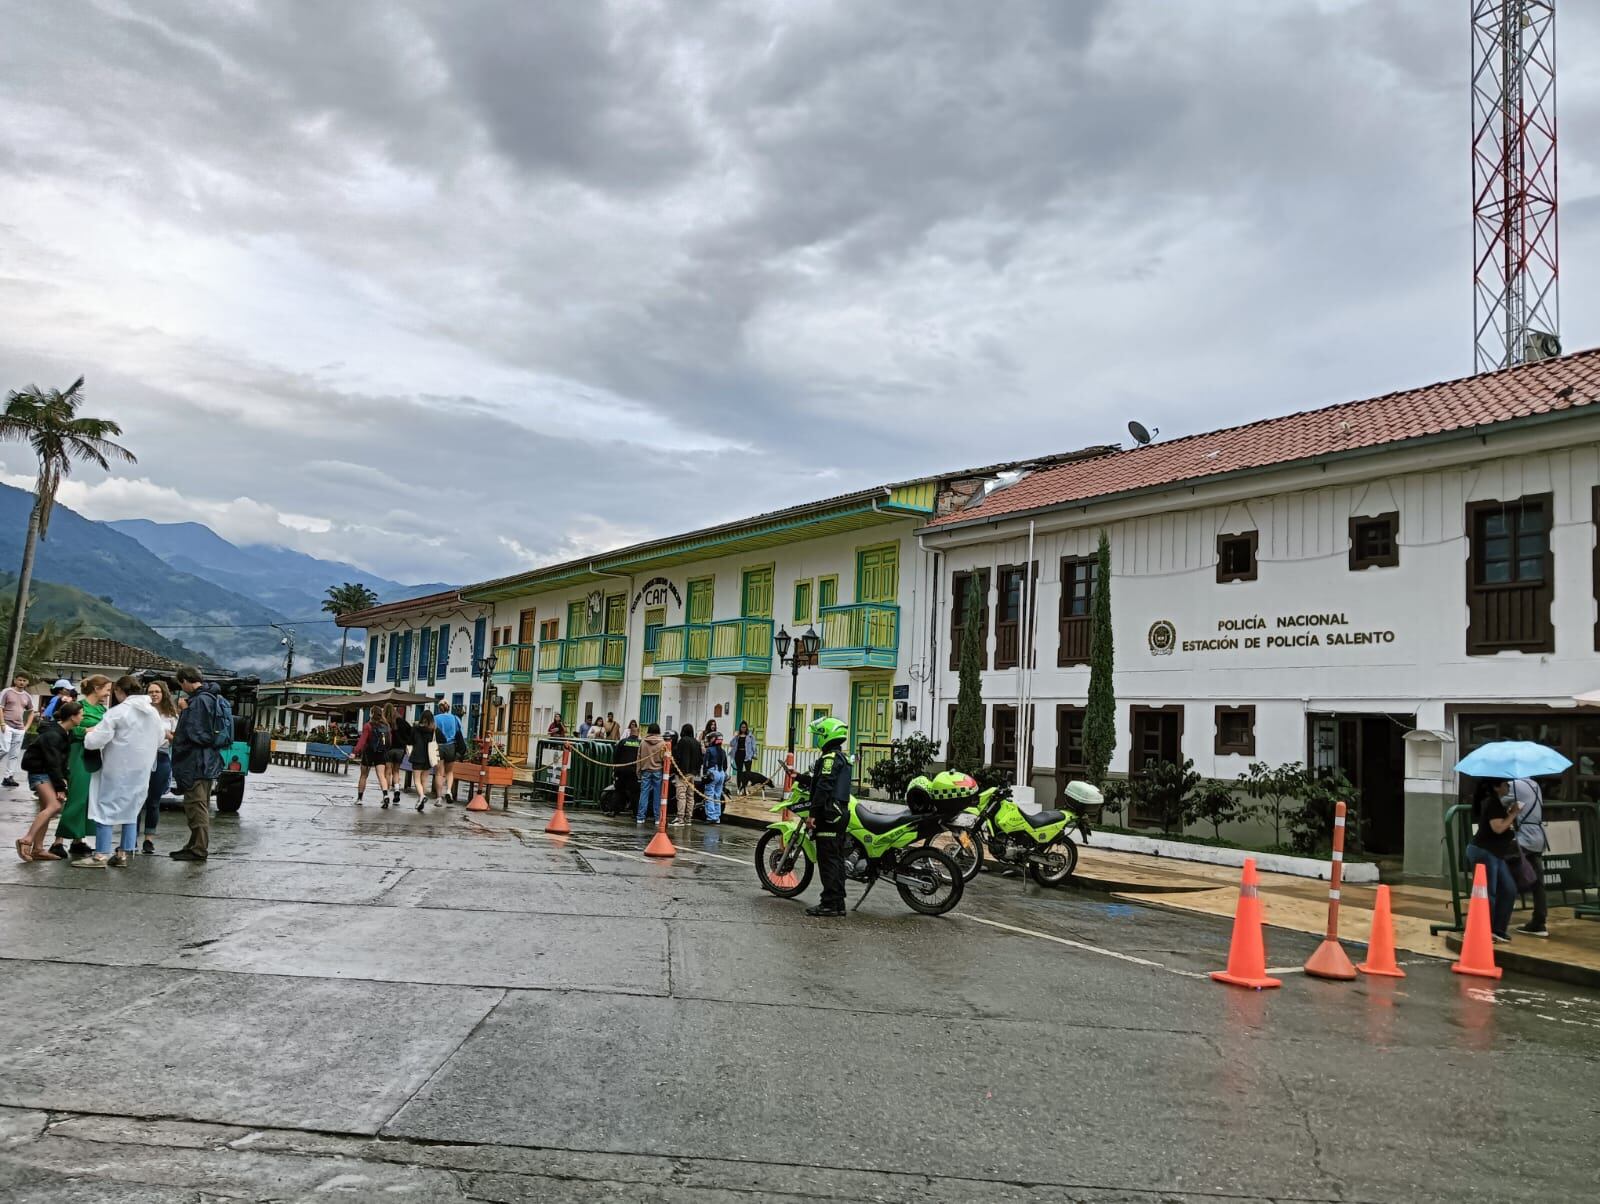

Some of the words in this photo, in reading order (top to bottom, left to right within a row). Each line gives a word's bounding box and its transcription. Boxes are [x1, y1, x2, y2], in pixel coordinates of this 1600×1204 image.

[645, 588, 668, 606] CAM
[1217, 613, 1267, 632] POLICÍA
[1276, 612, 1349, 629] NACIONAL
[1182, 635, 1239, 652] ESTACIÓN
[1244, 637, 1261, 649] DE
[1266, 631, 1320, 648] POLICÍA
[1326, 630, 1395, 646] SALENTO
